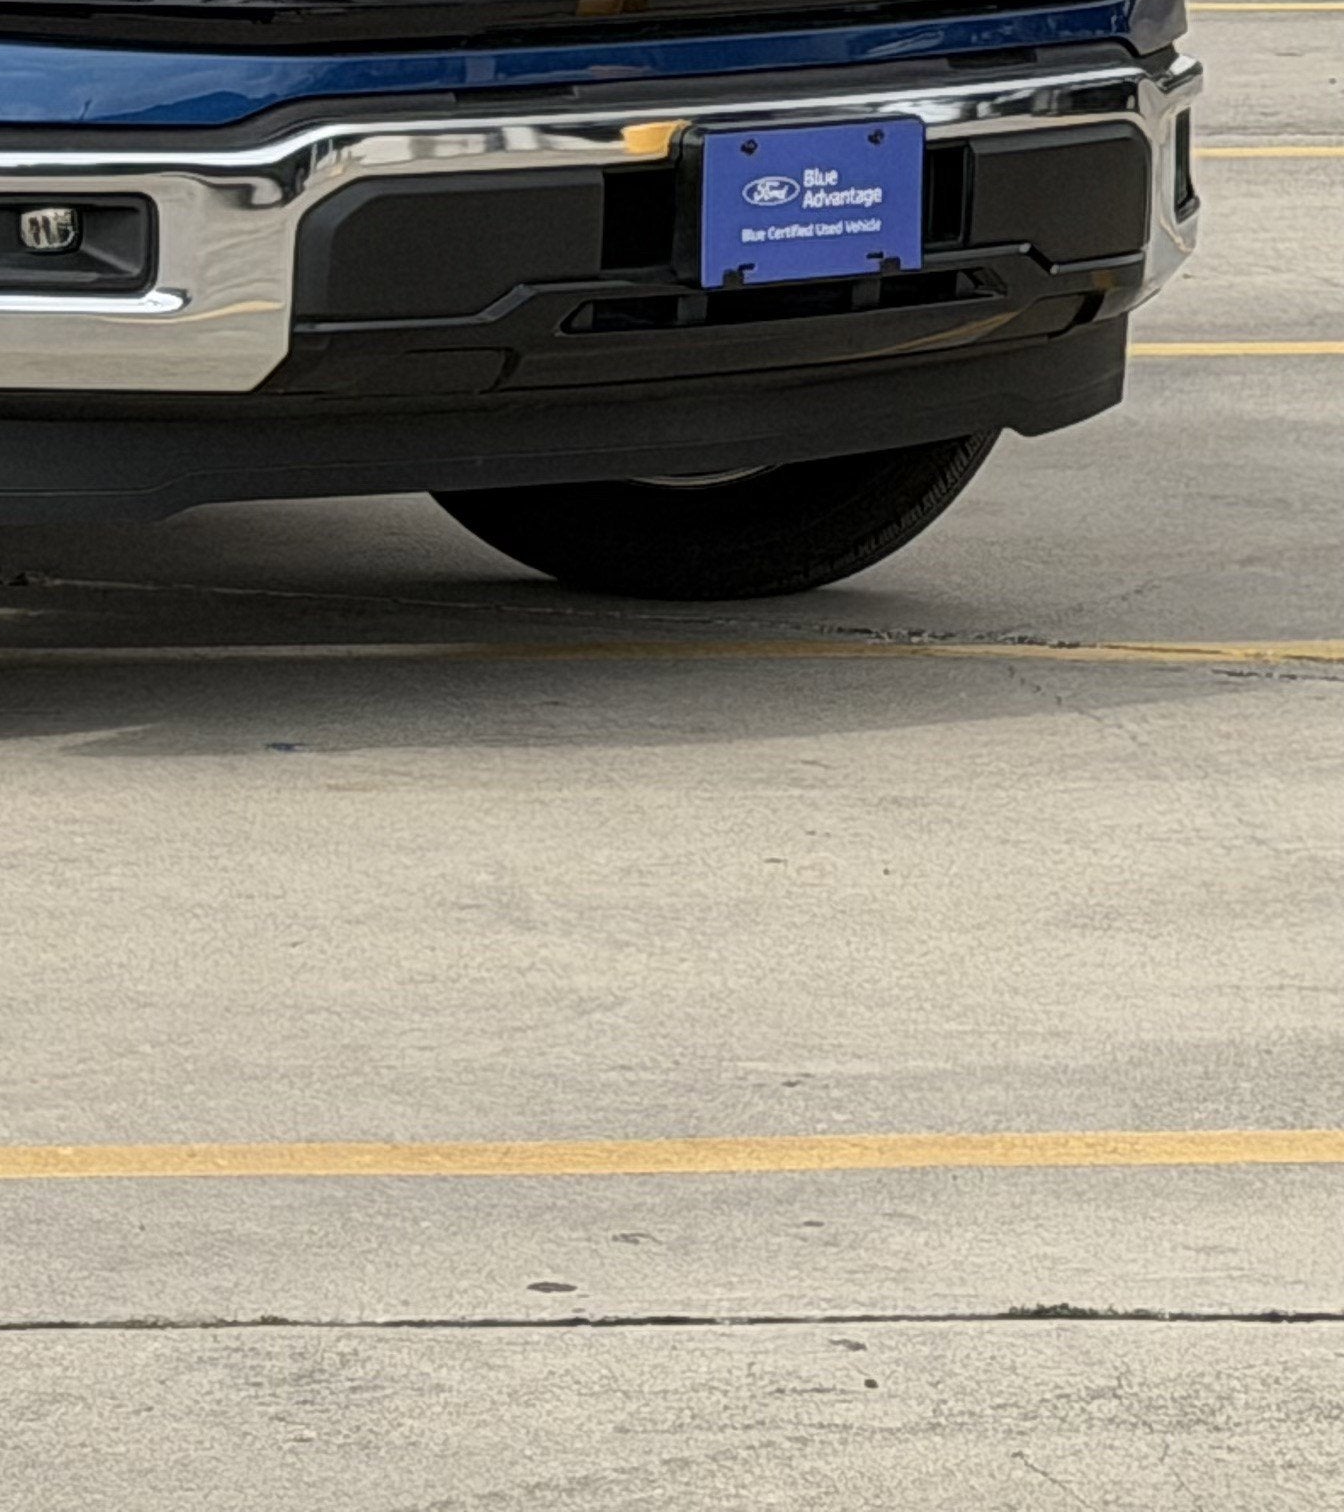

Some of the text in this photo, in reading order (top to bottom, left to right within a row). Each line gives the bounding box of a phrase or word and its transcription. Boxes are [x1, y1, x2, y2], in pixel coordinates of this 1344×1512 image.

[802, 168, 838, 188] Blue
[802, 187, 882, 209] Advantage
[741, 217, 882, 243] Blue Certified Used Vehicle
